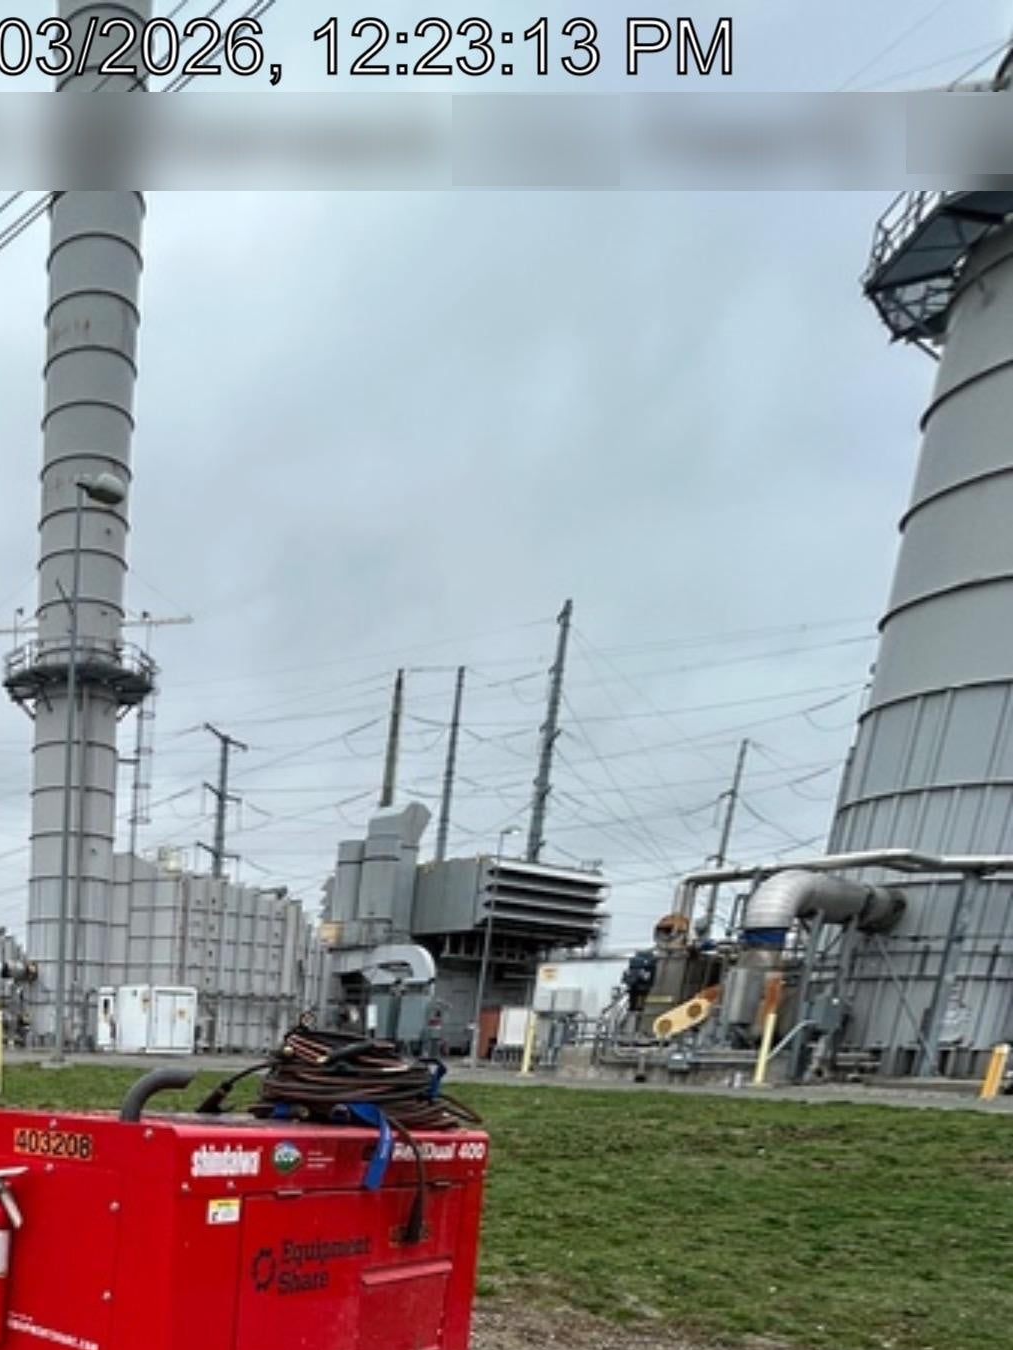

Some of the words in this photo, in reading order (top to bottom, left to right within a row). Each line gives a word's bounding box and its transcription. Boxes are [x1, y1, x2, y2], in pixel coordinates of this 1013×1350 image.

[15, 1129, 90, 1159] 403208
[458, 1142, 486, 1160] 400
[282, 1237, 370, 1266] Equipment
[277, 1269, 329, 1296] Share
